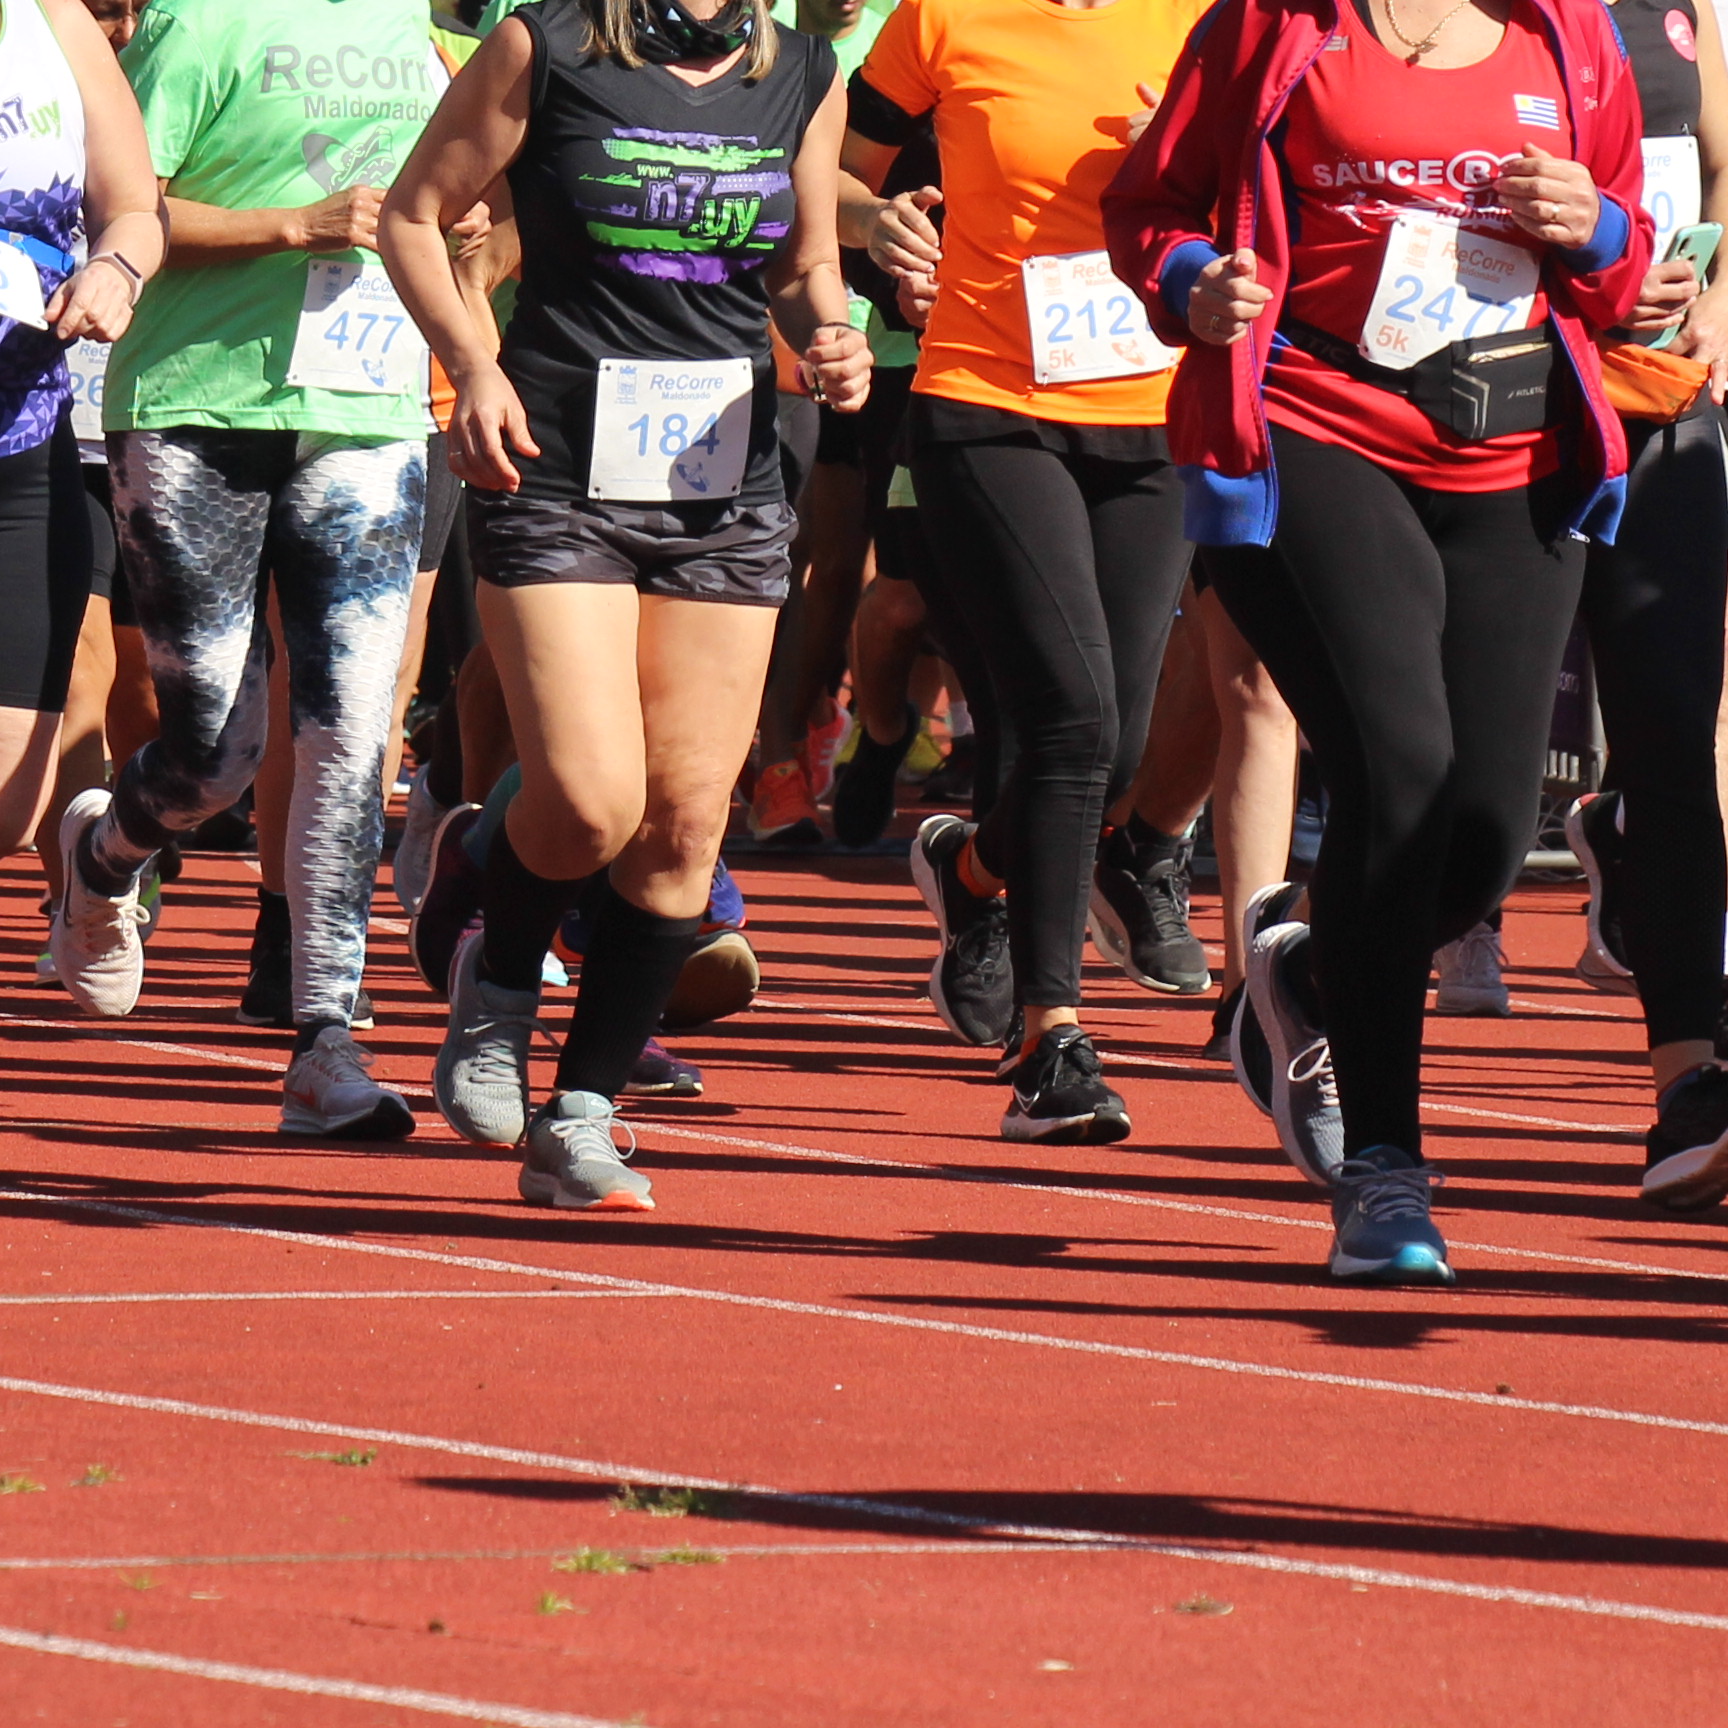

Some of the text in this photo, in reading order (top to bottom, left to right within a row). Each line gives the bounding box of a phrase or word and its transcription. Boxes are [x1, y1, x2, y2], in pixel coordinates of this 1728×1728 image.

[260, 44, 428, 93] ReCorr
[303, 95, 431, 122] Maldonado
[1312, 159, 1444, 187] SAUCE
[1441, 241, 1515, 276] ReCorre
[323, 311, 405, 354] 477
[1045, 295, 1153, 343] 212
[1376, 324, 1409, 353] 5k
[1048, 348, 1076, 370] 5k
[649, 374, 724, 391] ReCorre
[662, 392, 711, 401] Maldonado
[628, 412, 720, 457] 184
